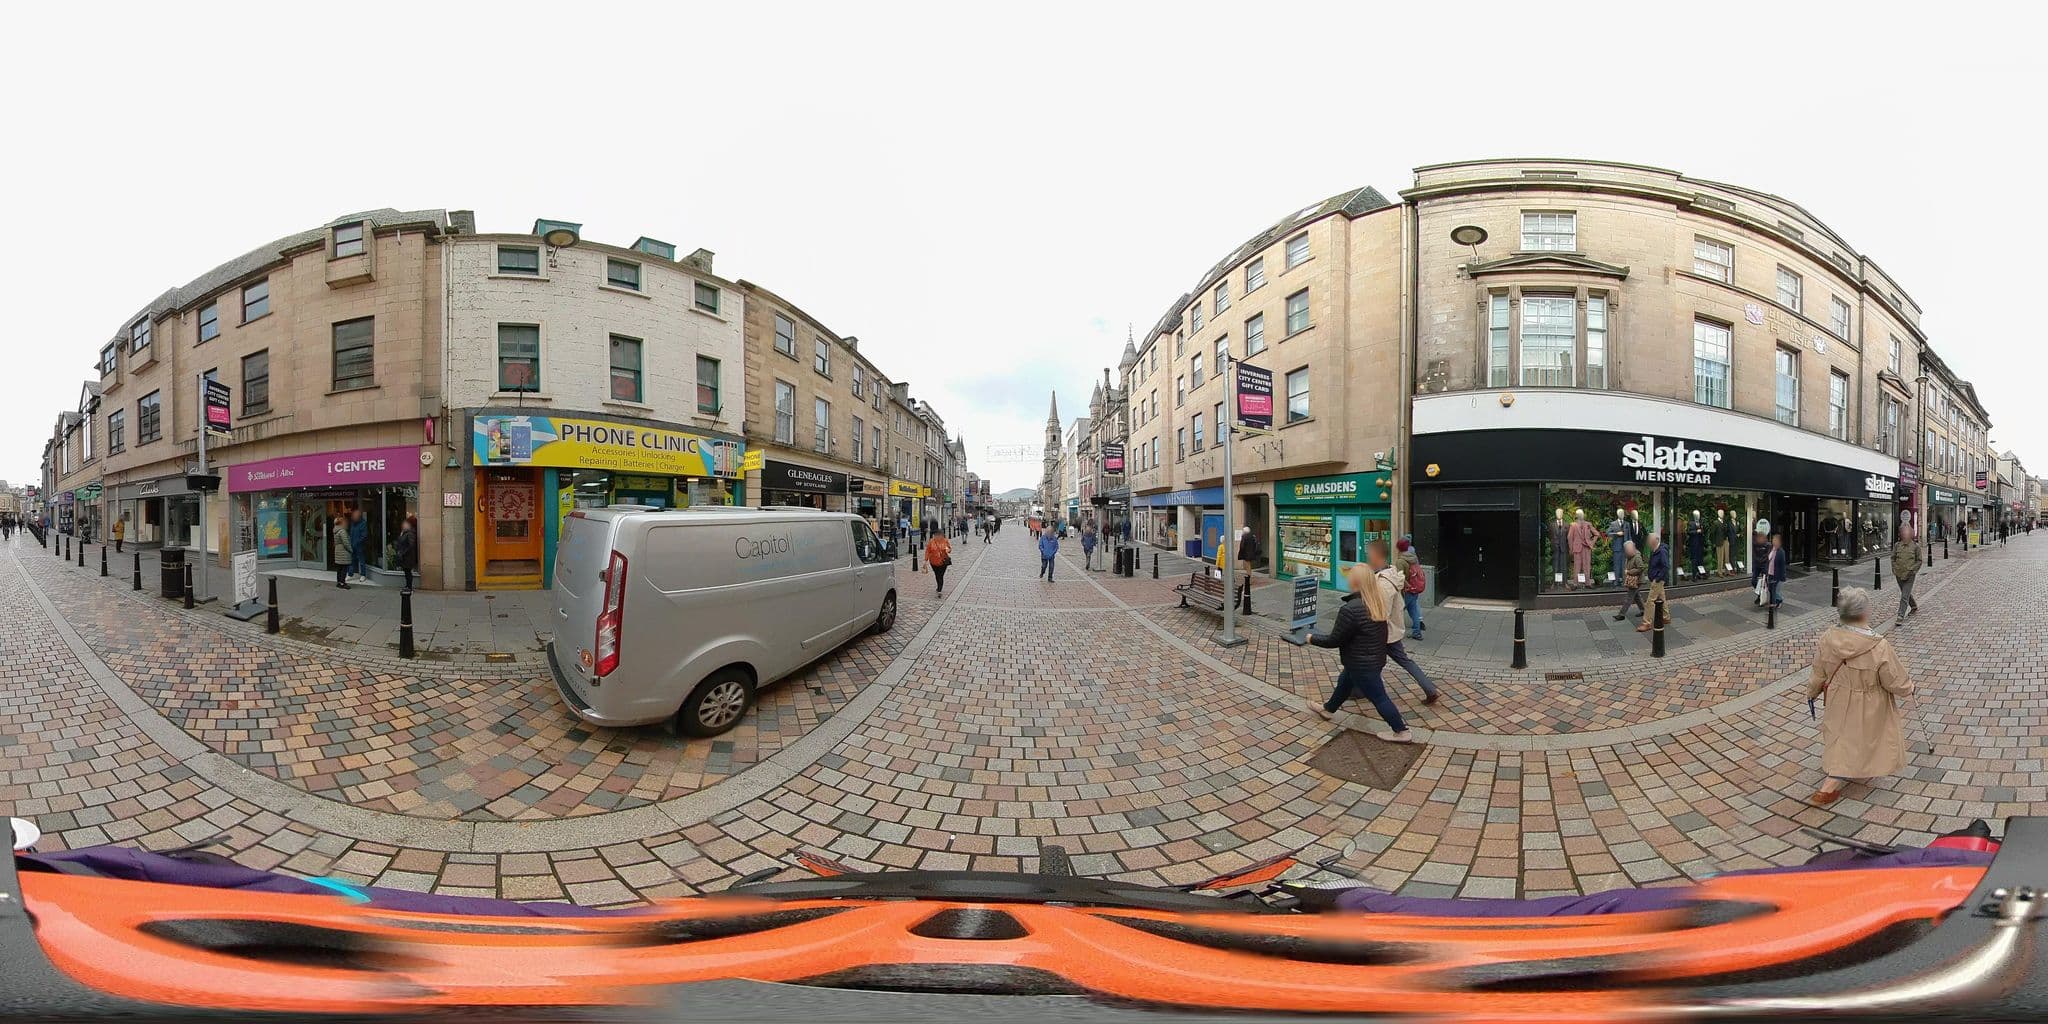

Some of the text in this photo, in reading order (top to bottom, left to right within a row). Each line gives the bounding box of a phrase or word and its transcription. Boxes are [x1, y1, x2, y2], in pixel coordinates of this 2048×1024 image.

[1240, 369, 1270, 380] INVERNESS
[1251, 378, 1271, 387] CENTRE
[561, 424, 698, 454] PHONE CLINIC
[591, 445, 676, 462] Accessories Unlocking
[744, 453, 761, 461] PHONE
[1622, 436, 1721, 473] slater
[335, 459, 386, 473] CENTRE
[579, 456, 685, 472] Repairing Batteries Charger
[744, 460, 761, 468] CLINIC
[787, 469, 833, 483] GLENEAGLES
[1635, 470, 1711, 485] MENSWEAR
[1303, 481, 1357, 494] RAMSDENS
[1865, 473, 1896, 494] slater
[735, 531, 790, 560] Capitol
